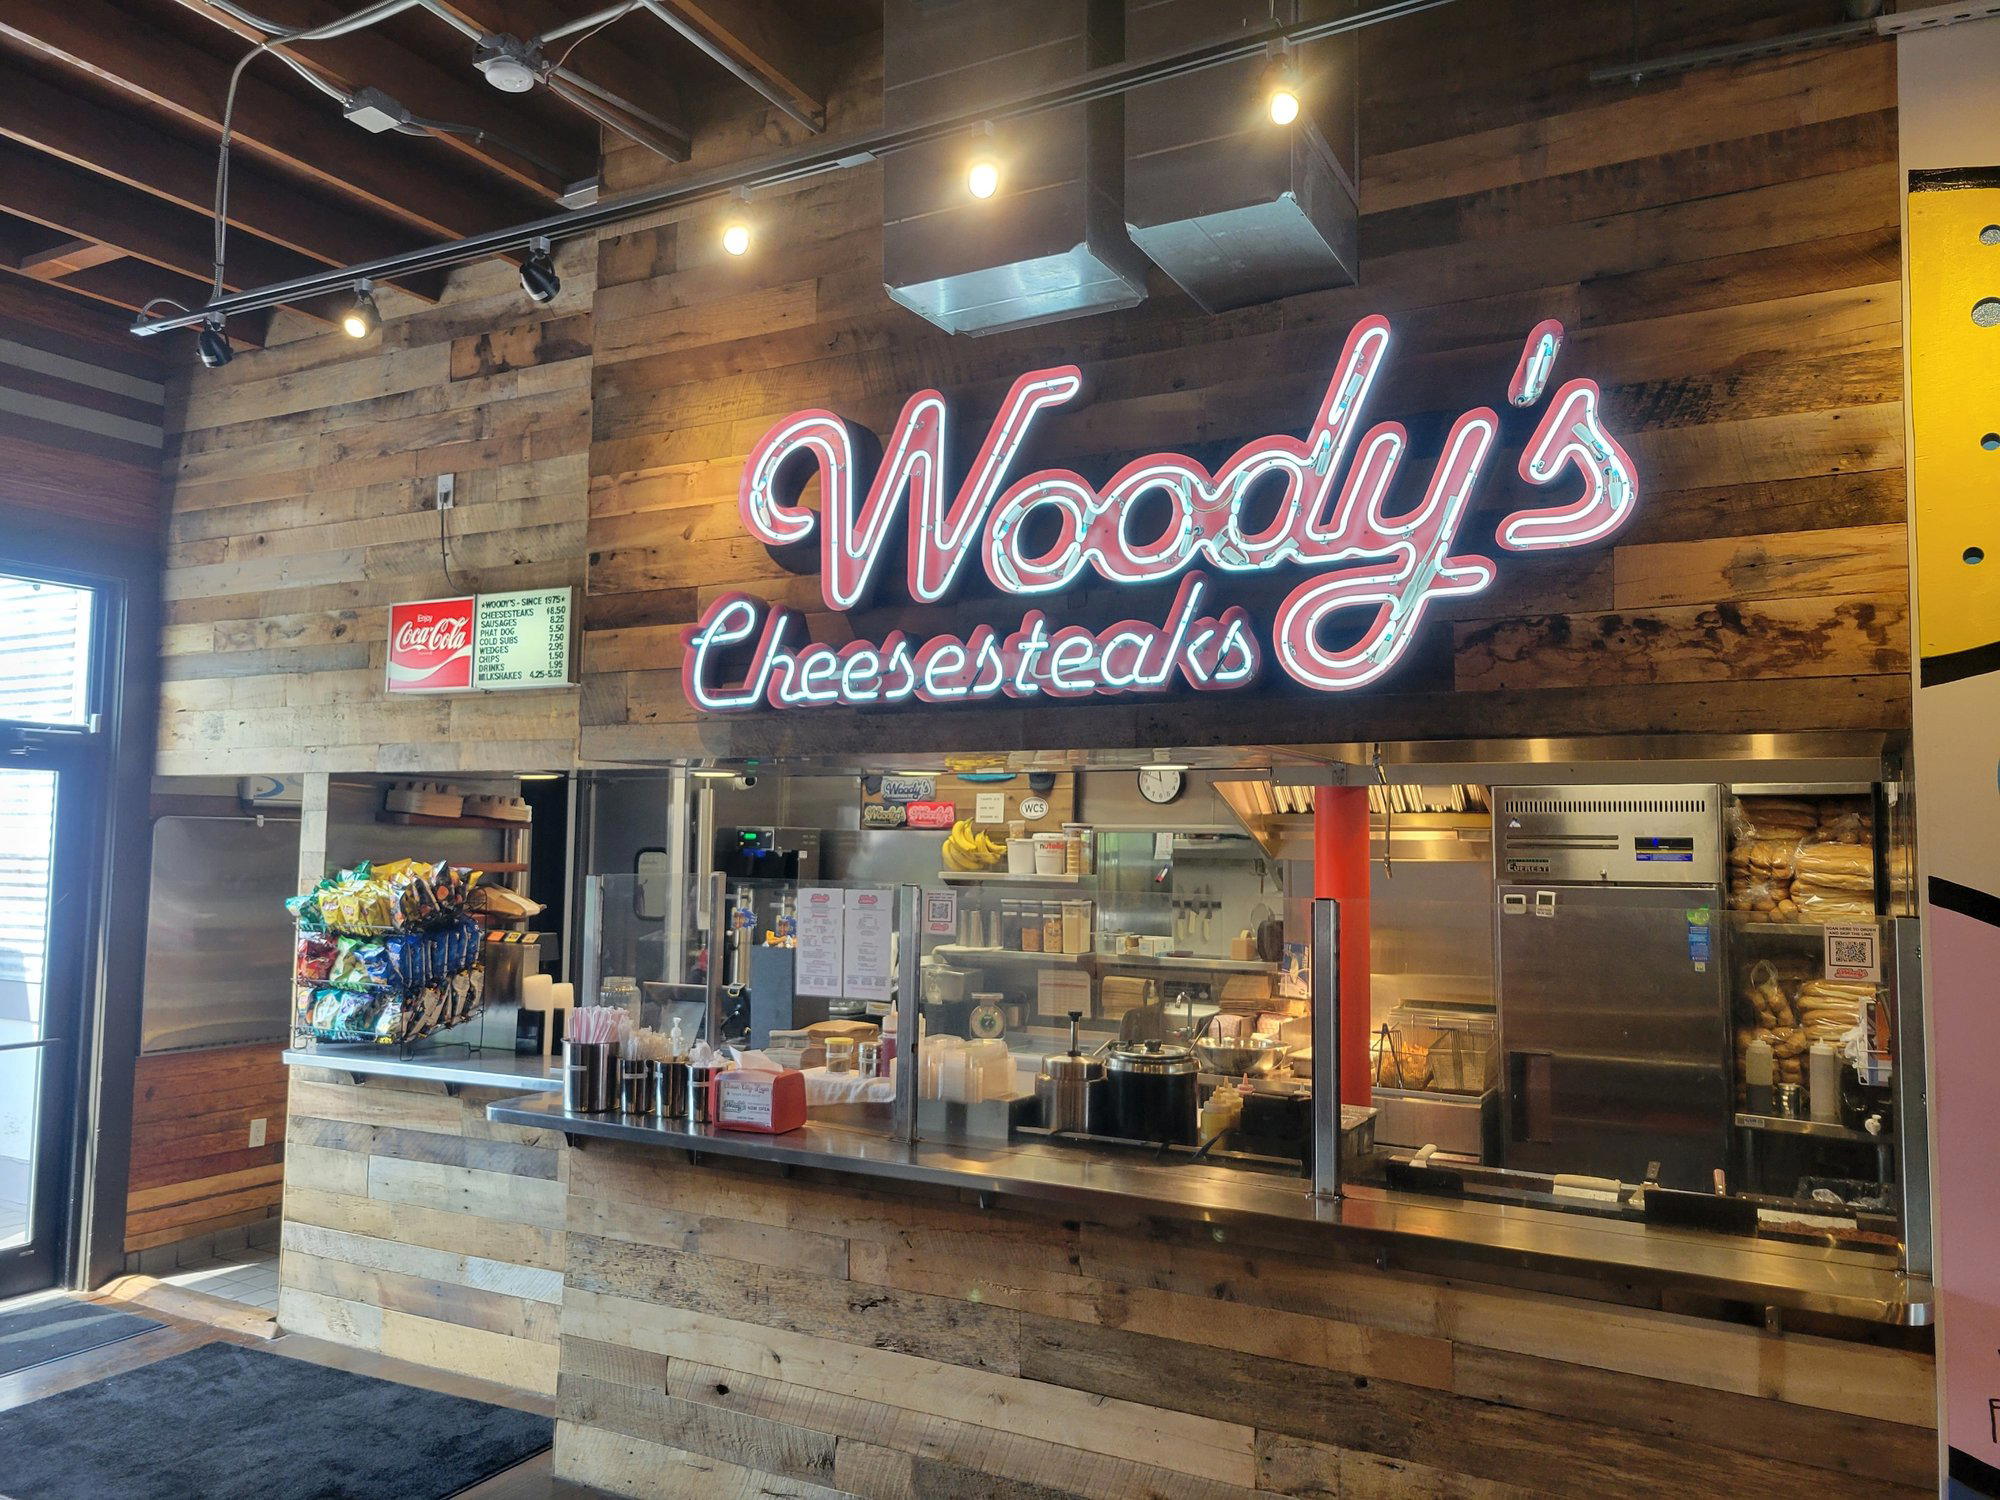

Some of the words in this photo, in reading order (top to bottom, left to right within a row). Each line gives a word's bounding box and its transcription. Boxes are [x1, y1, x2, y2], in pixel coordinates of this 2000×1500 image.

[738, 314, 1639, 692] Woody's
[485, 599, 516, 608] WOODY'S
[521, 597, 542, 606] SINCE
[545, 595, 561, 604] 1975
[481, 608, 534, 619] CHEESESTEAKS
[481, 619, 517, 628] SAUSAGES
[549, 615, 564, 623] 8.25
[480, 628, 497, 637] PHAT
[500, 627, 515, 636] DOG
[549, 624, 565, 632] 5.50
[480, 638, 497, 646] COLD
[500, 636, 518, 645] SUBS
[549, 633, 564, 641] 7.50
[682, 570, 1260, 713] Cheesesteaks
[480, 645, 509, 654] WEDGES
[548, 642, 564, 651] 2.95
[479, 654, 500, 663] CHIPS
[548, 651, 564, 660] 1.50
[479, 663, 505, 672] DRINKS
[548, 660, 563, 669] 1.95
[479, 671, 522, 681] MILKSHAKES
[529, 670, 562, 679] 4.25-5.25
[885, 780, 931, 800] Woody's
[1024, 803, 1044, 813] WCS
